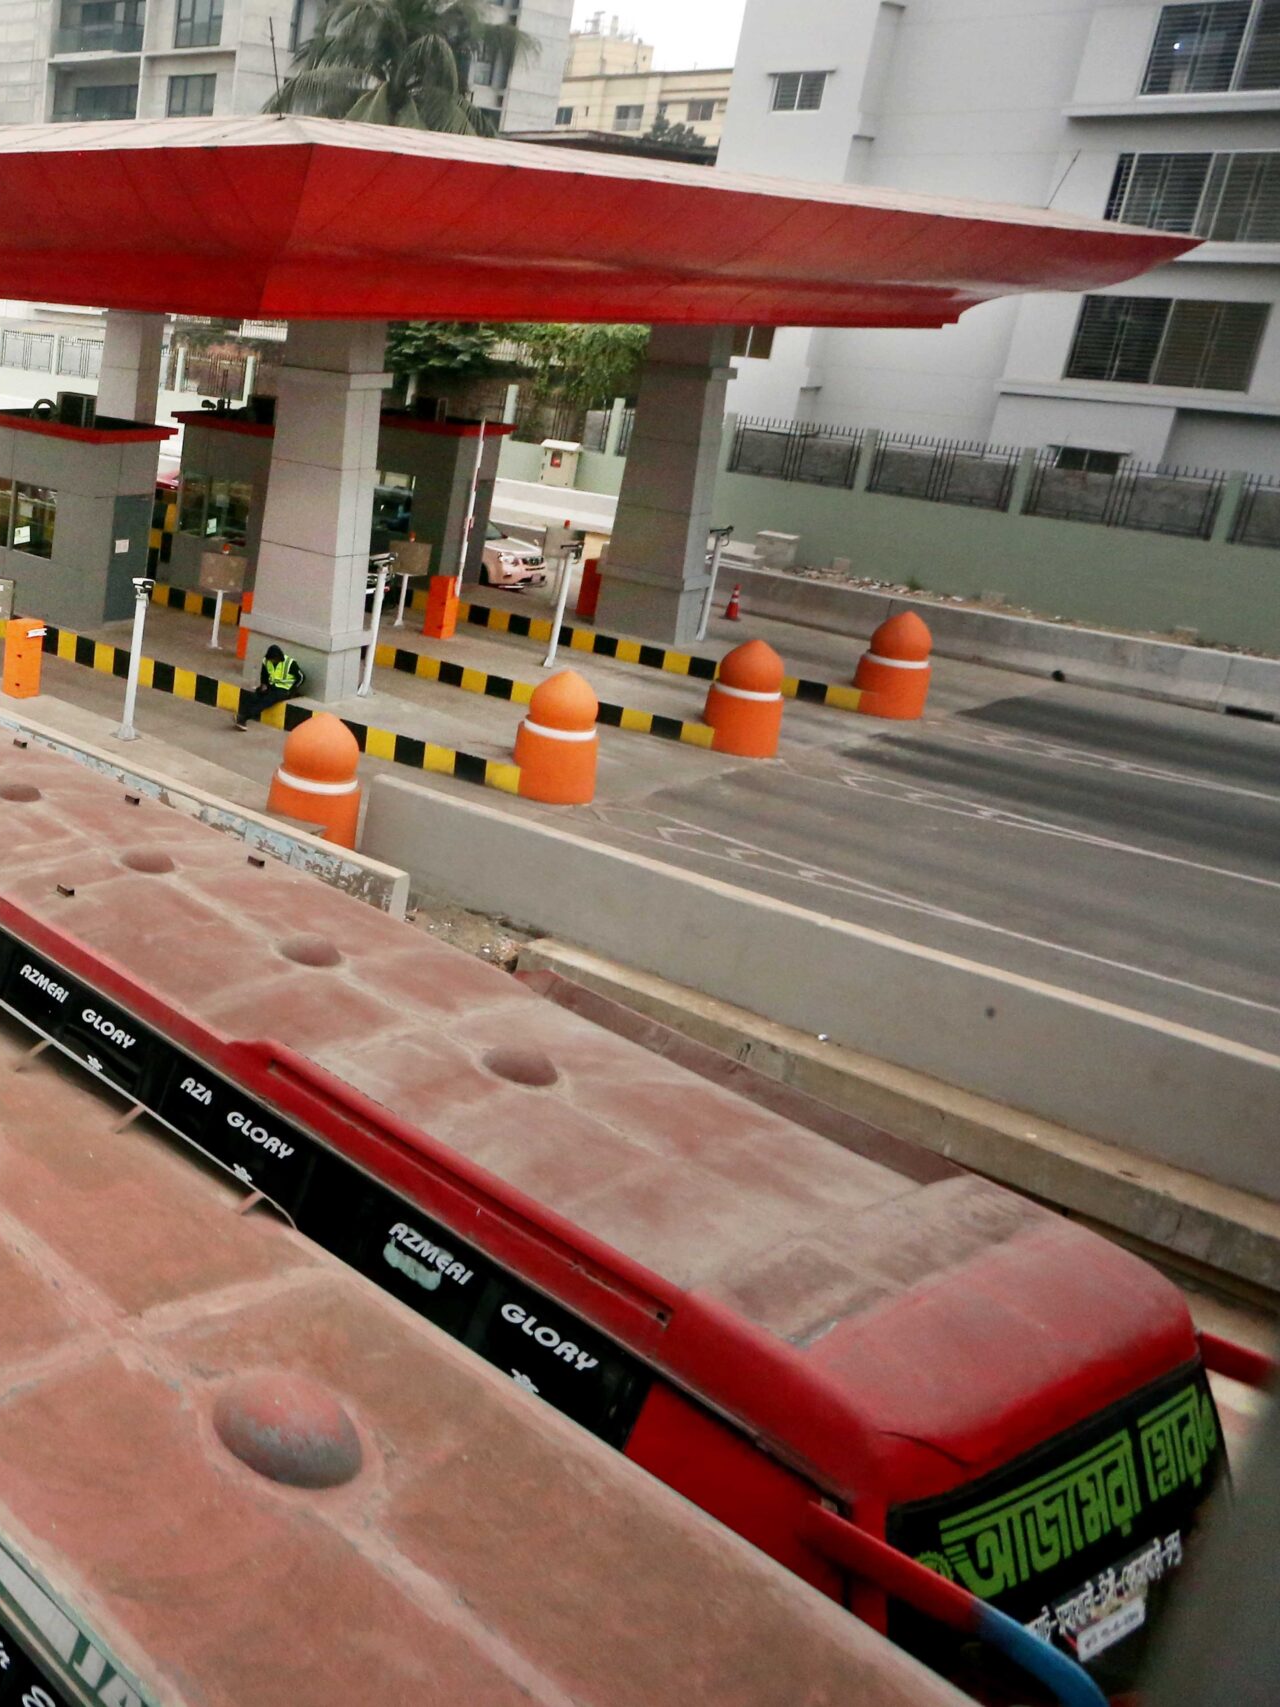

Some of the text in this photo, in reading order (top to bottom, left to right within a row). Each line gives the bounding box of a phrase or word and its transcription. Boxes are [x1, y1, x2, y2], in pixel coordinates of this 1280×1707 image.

[19, 963, 136, 1049] AZMERI GLORY
[226, 1111, 295, 1159] GLORY
[388, 1222, 599, 1371] AZMERI GLORY
